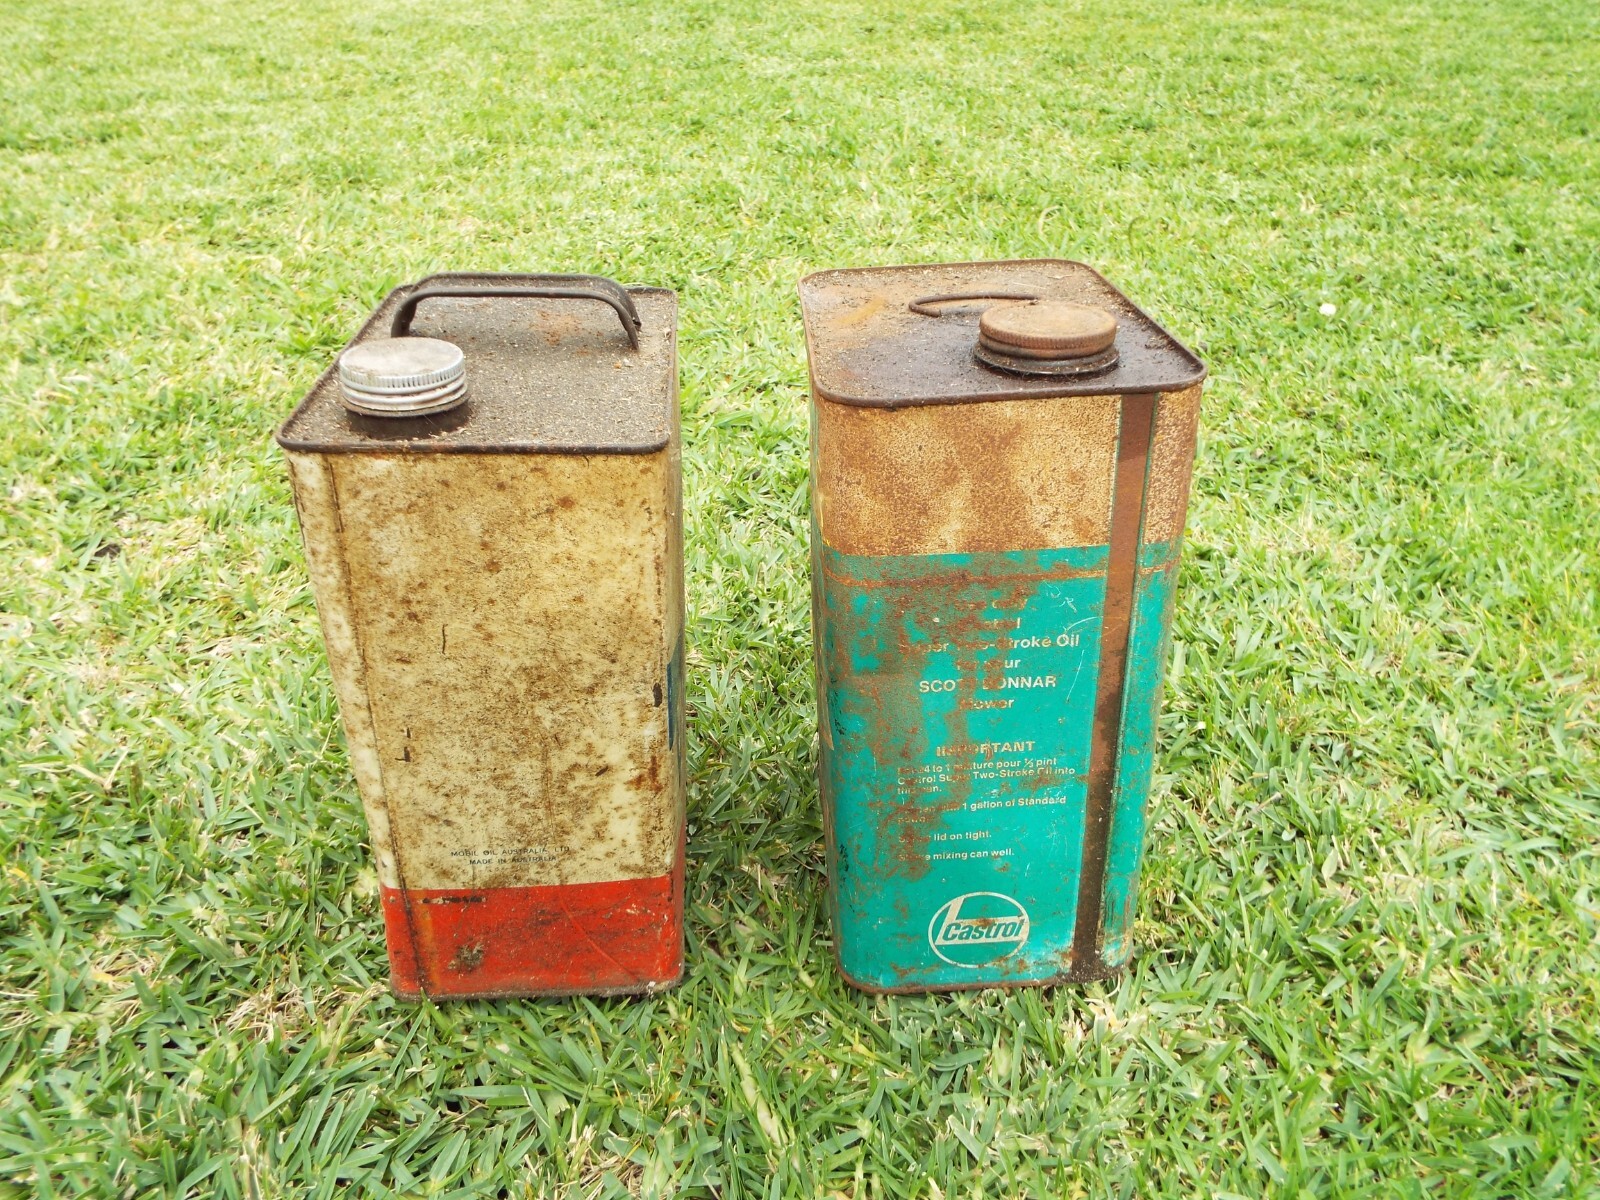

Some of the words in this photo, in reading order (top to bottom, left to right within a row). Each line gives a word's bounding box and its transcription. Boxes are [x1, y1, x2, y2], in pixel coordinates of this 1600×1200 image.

[1056, 633, 1080, 648] Oil
[932, 764, 943, 773] to
[996, 760, 1022, 770] pour
[1036, 757, 1057, 768] pint
[972, 768, 1035, 780] Two-Stroke
[1054, 766, 1076, 776] into
[962, 802, 967, 811] 1
[970, 799, 1003, 812] gallon
[1005, 798, 1016, 807] of
[1018, 795, 1067, 806] Standard
[933, 832, 948, 841] lid
[949, 832, 963, 841] on
[965, 830, 993, 841] tight.
[451, 849, 479, 857] MOBIL
[933, 850, 968, 861] mixing
[969, 849, 989, 859] can
[990, 847, 1015, 858] well.
[469, 857, 493, 865] MADE
[941, 919, 1026, 942] Castrol
